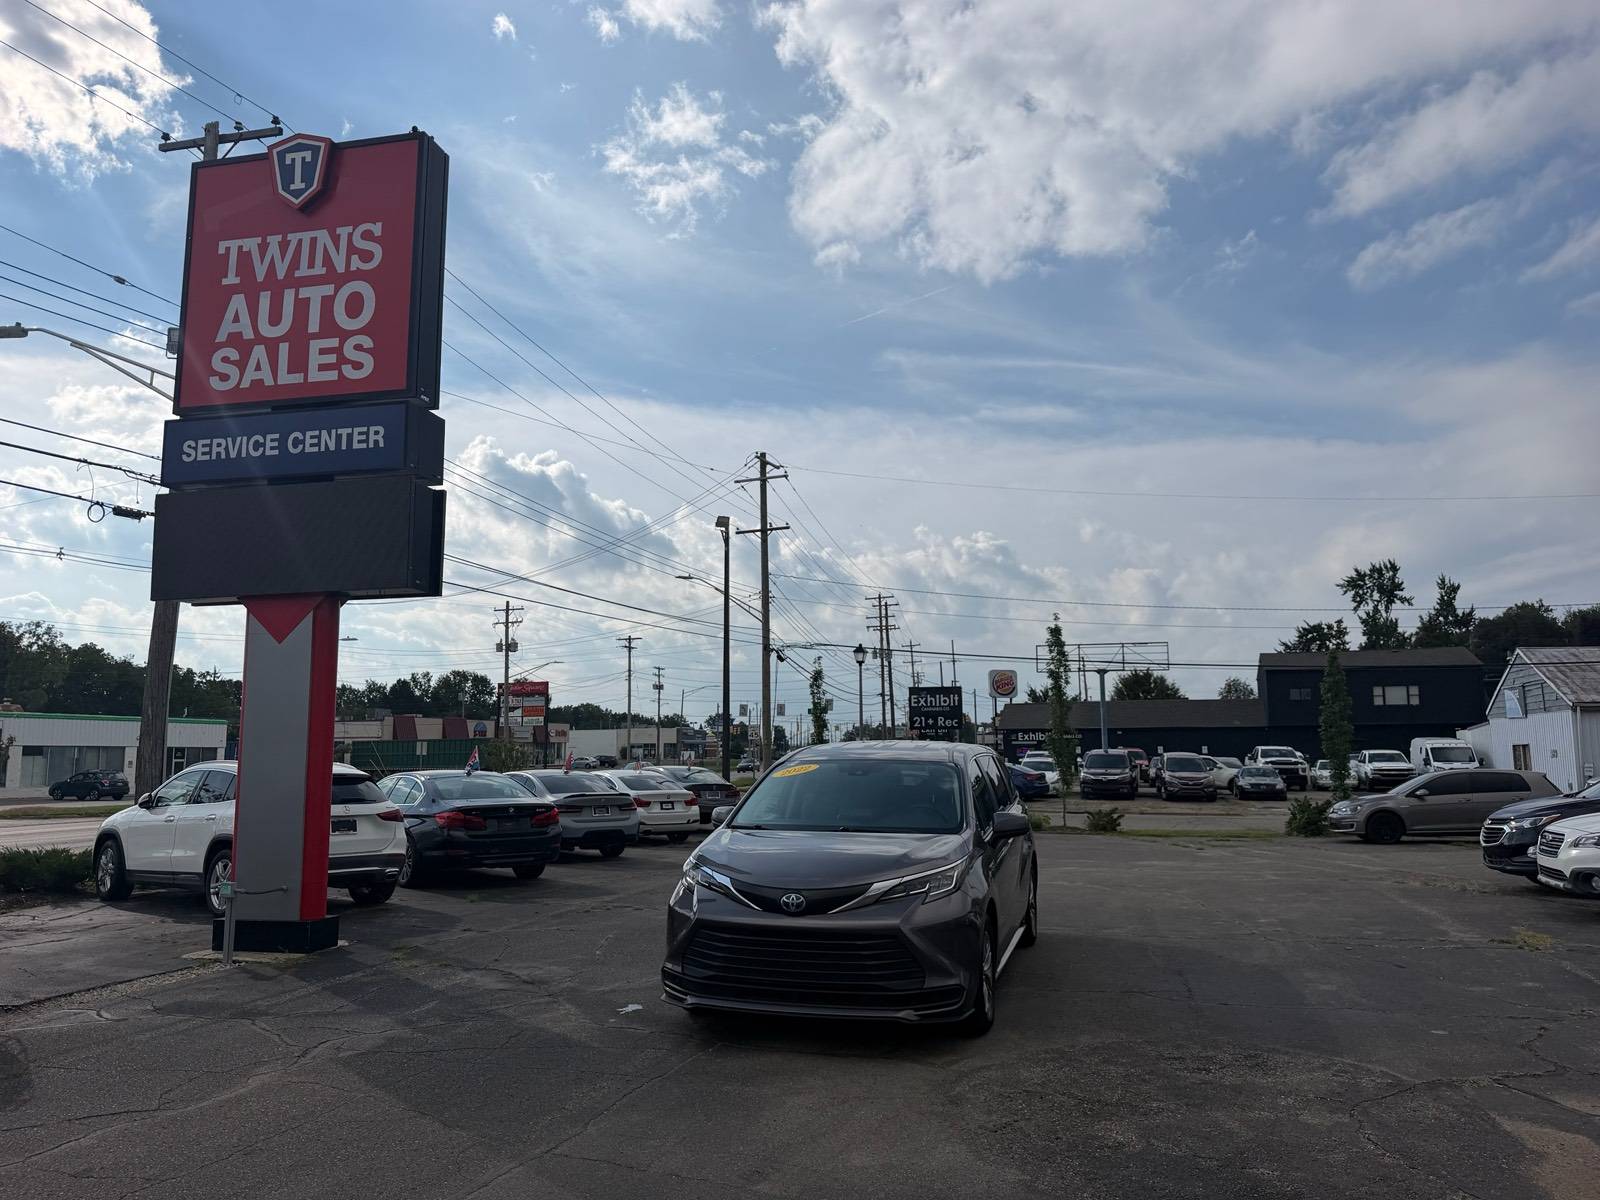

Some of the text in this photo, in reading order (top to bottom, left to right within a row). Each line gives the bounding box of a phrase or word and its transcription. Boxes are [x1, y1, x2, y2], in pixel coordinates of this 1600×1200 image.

[285, 151, 311, 190] T
[218, 222, 383, 285] TWINS
[215, 280, 376, 342] AUTO
[209, 335, 374, 391] SALES
[181, 425, 384, 463] SERVICE CENTER
[911, 694, 959, 706] Exhibit
[913, 717, 958, 727] 21+ Rec
